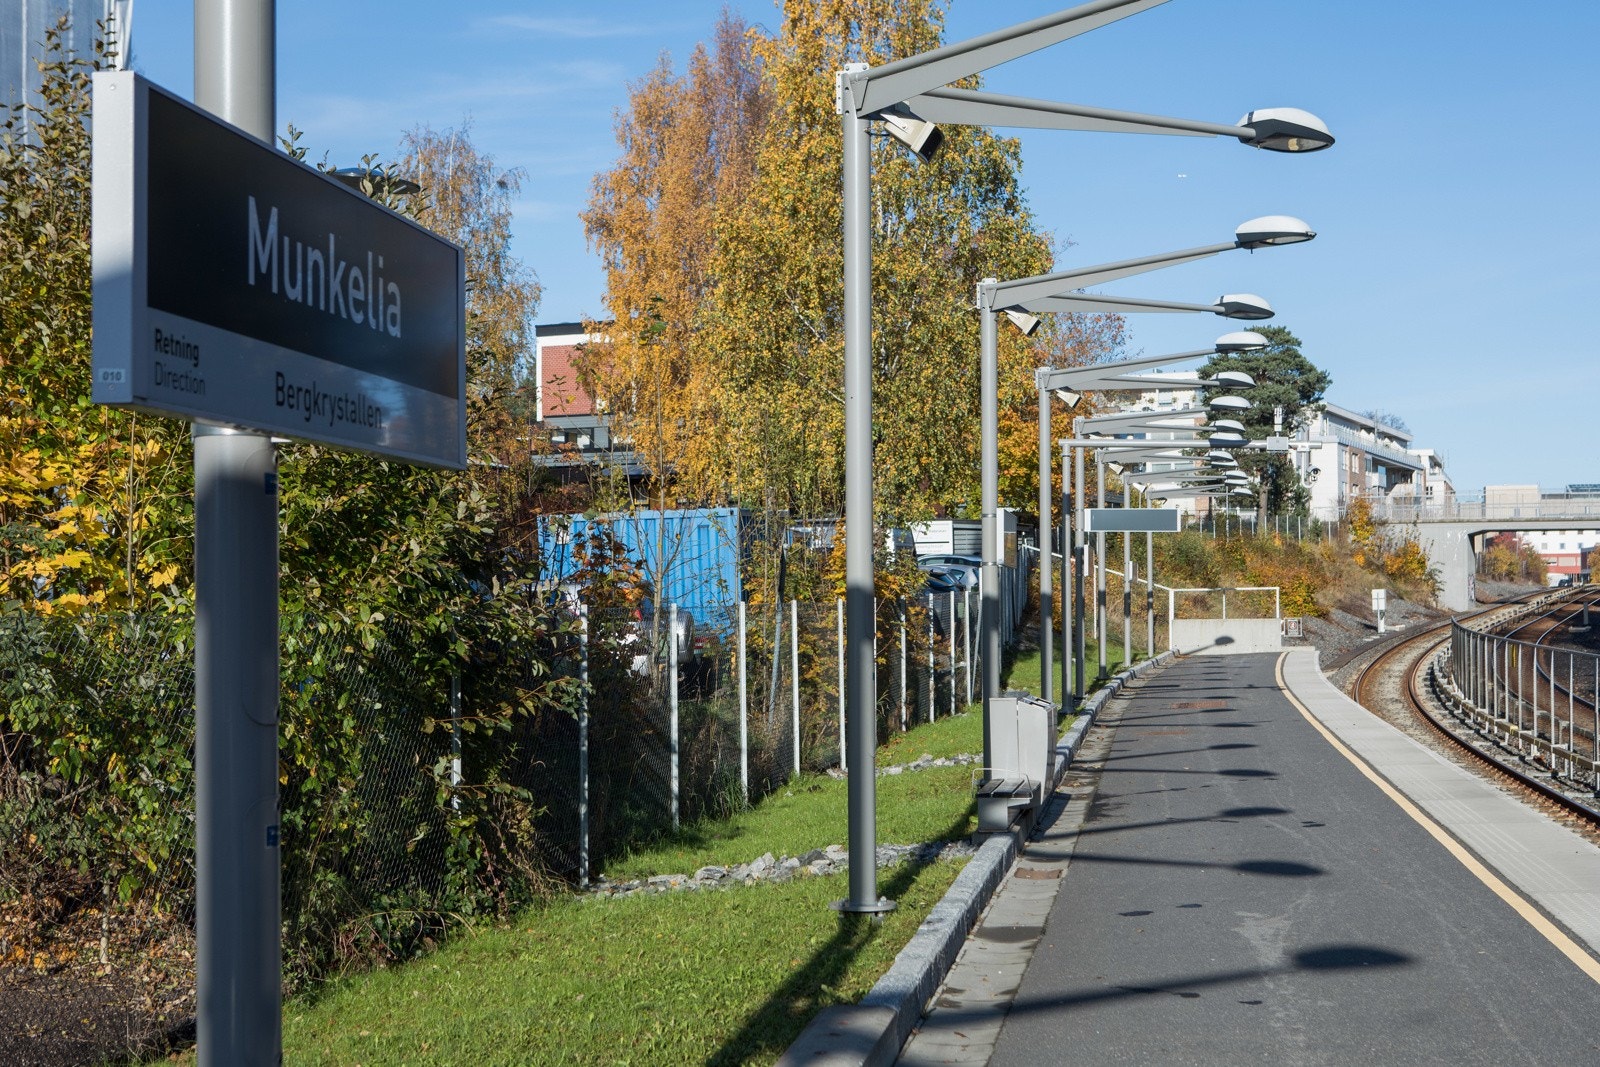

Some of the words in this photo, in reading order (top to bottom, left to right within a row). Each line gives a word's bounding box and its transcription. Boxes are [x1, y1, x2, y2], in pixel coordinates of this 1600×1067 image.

[248, 196, 402, 338] Munkelia
[154, 328, 199, 368] Retning
[102, 371, 122, 381] 010
[154, 361, 206, 395] Direction
[275, 371, 382, 428] Bergkrystallen
